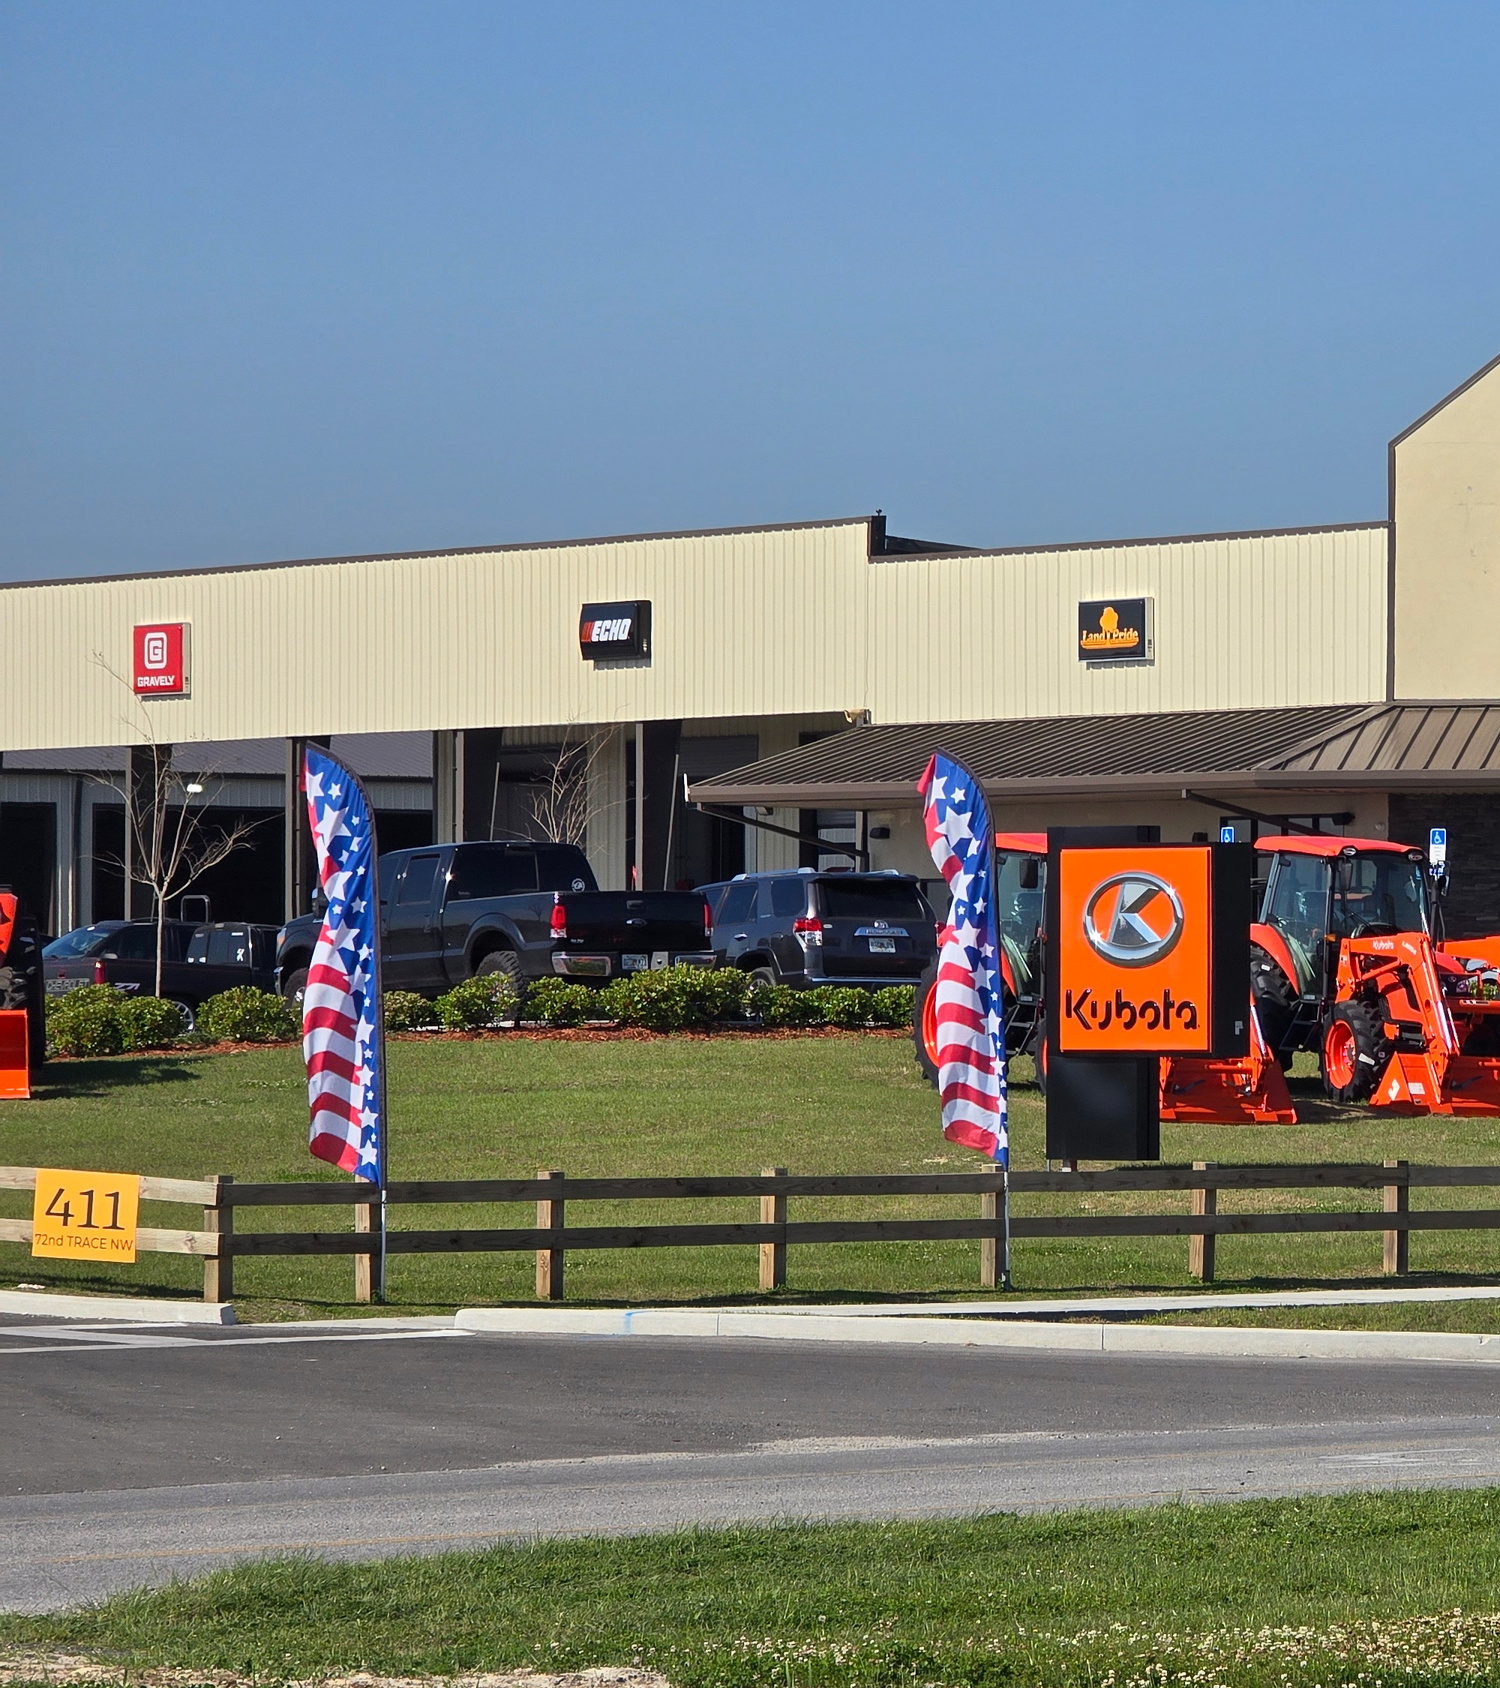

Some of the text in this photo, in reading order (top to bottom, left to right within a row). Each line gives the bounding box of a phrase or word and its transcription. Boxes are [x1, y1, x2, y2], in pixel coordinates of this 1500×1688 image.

[591, 618, 632, 642] ECHO
[1082, 627, 1139, 643] Land Pride
[137, 675, 175, 687] GRAVELY
[1065, 988, 1198, 1031] Kubota
[45, 1188, 125, 1231] 411
[35, 1233, 134, 1251] 72nd TRACE NW
